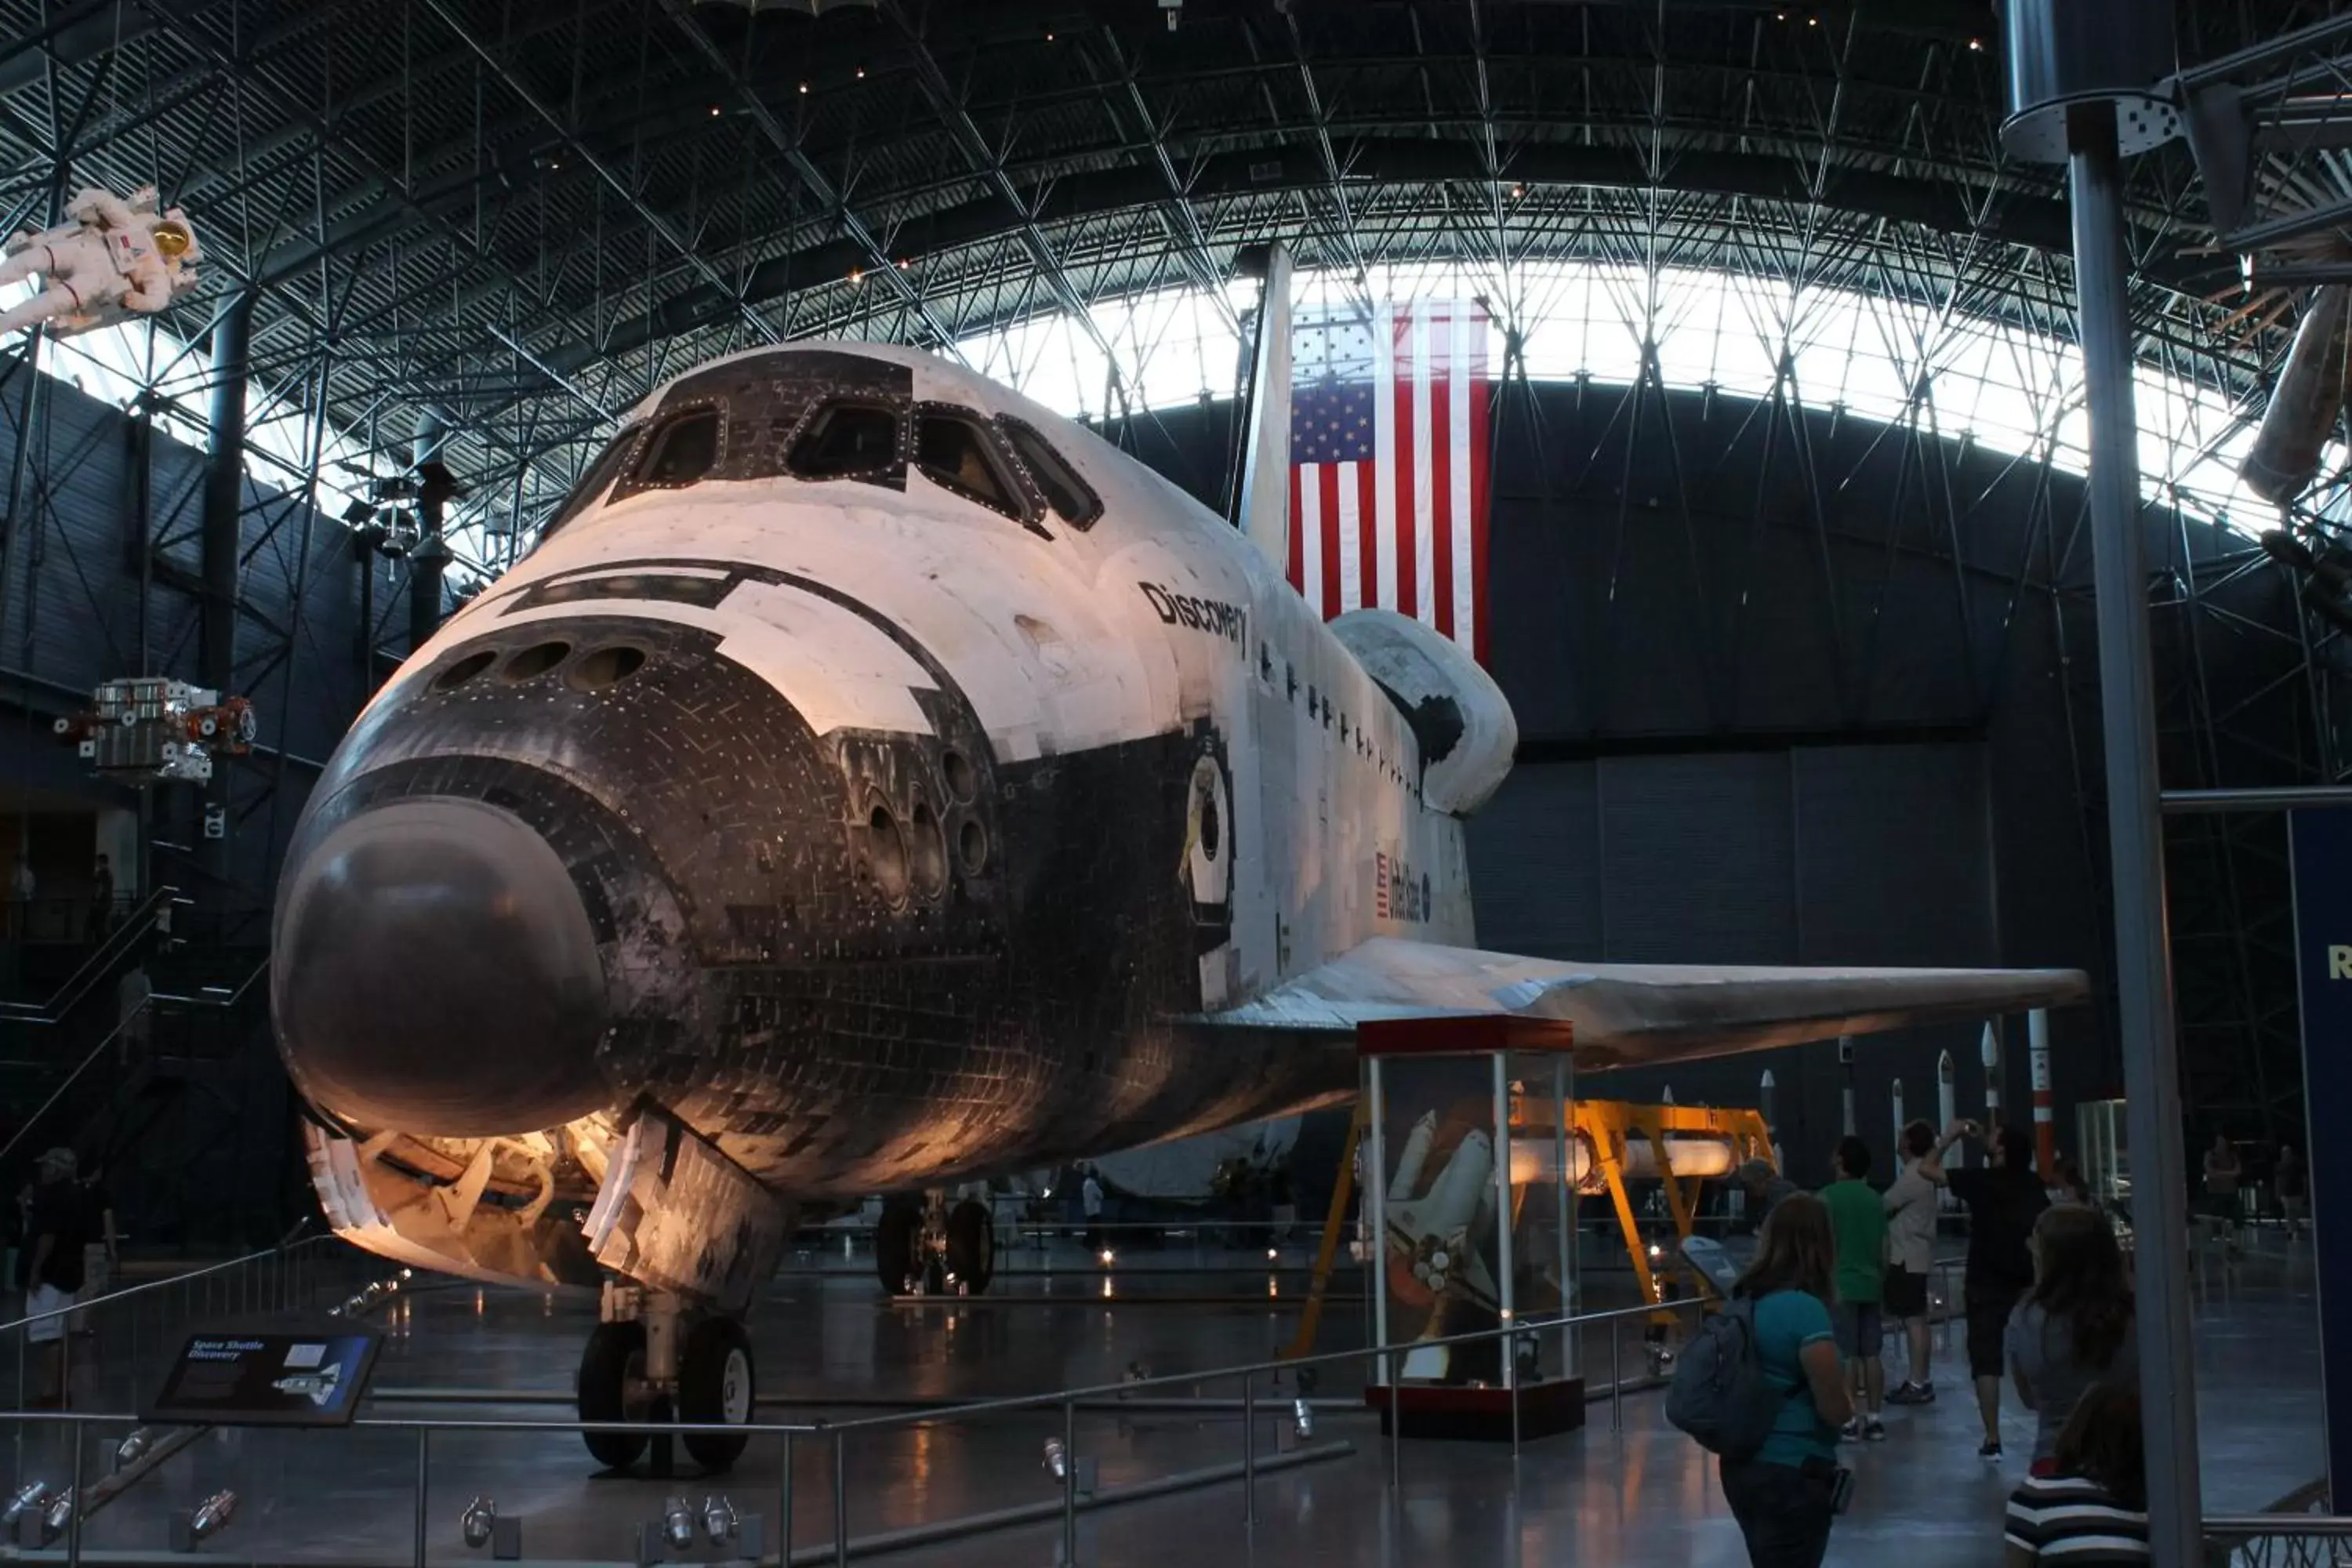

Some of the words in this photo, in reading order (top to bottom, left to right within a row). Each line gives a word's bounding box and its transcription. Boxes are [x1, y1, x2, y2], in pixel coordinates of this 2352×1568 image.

[1138, 582, 1246, 662] Discovery
[193, 1341, 224, 1351] Space
[226, 1341, 264, 1350] Shuttle
[188, 1350, 241, 1361] Discovery
